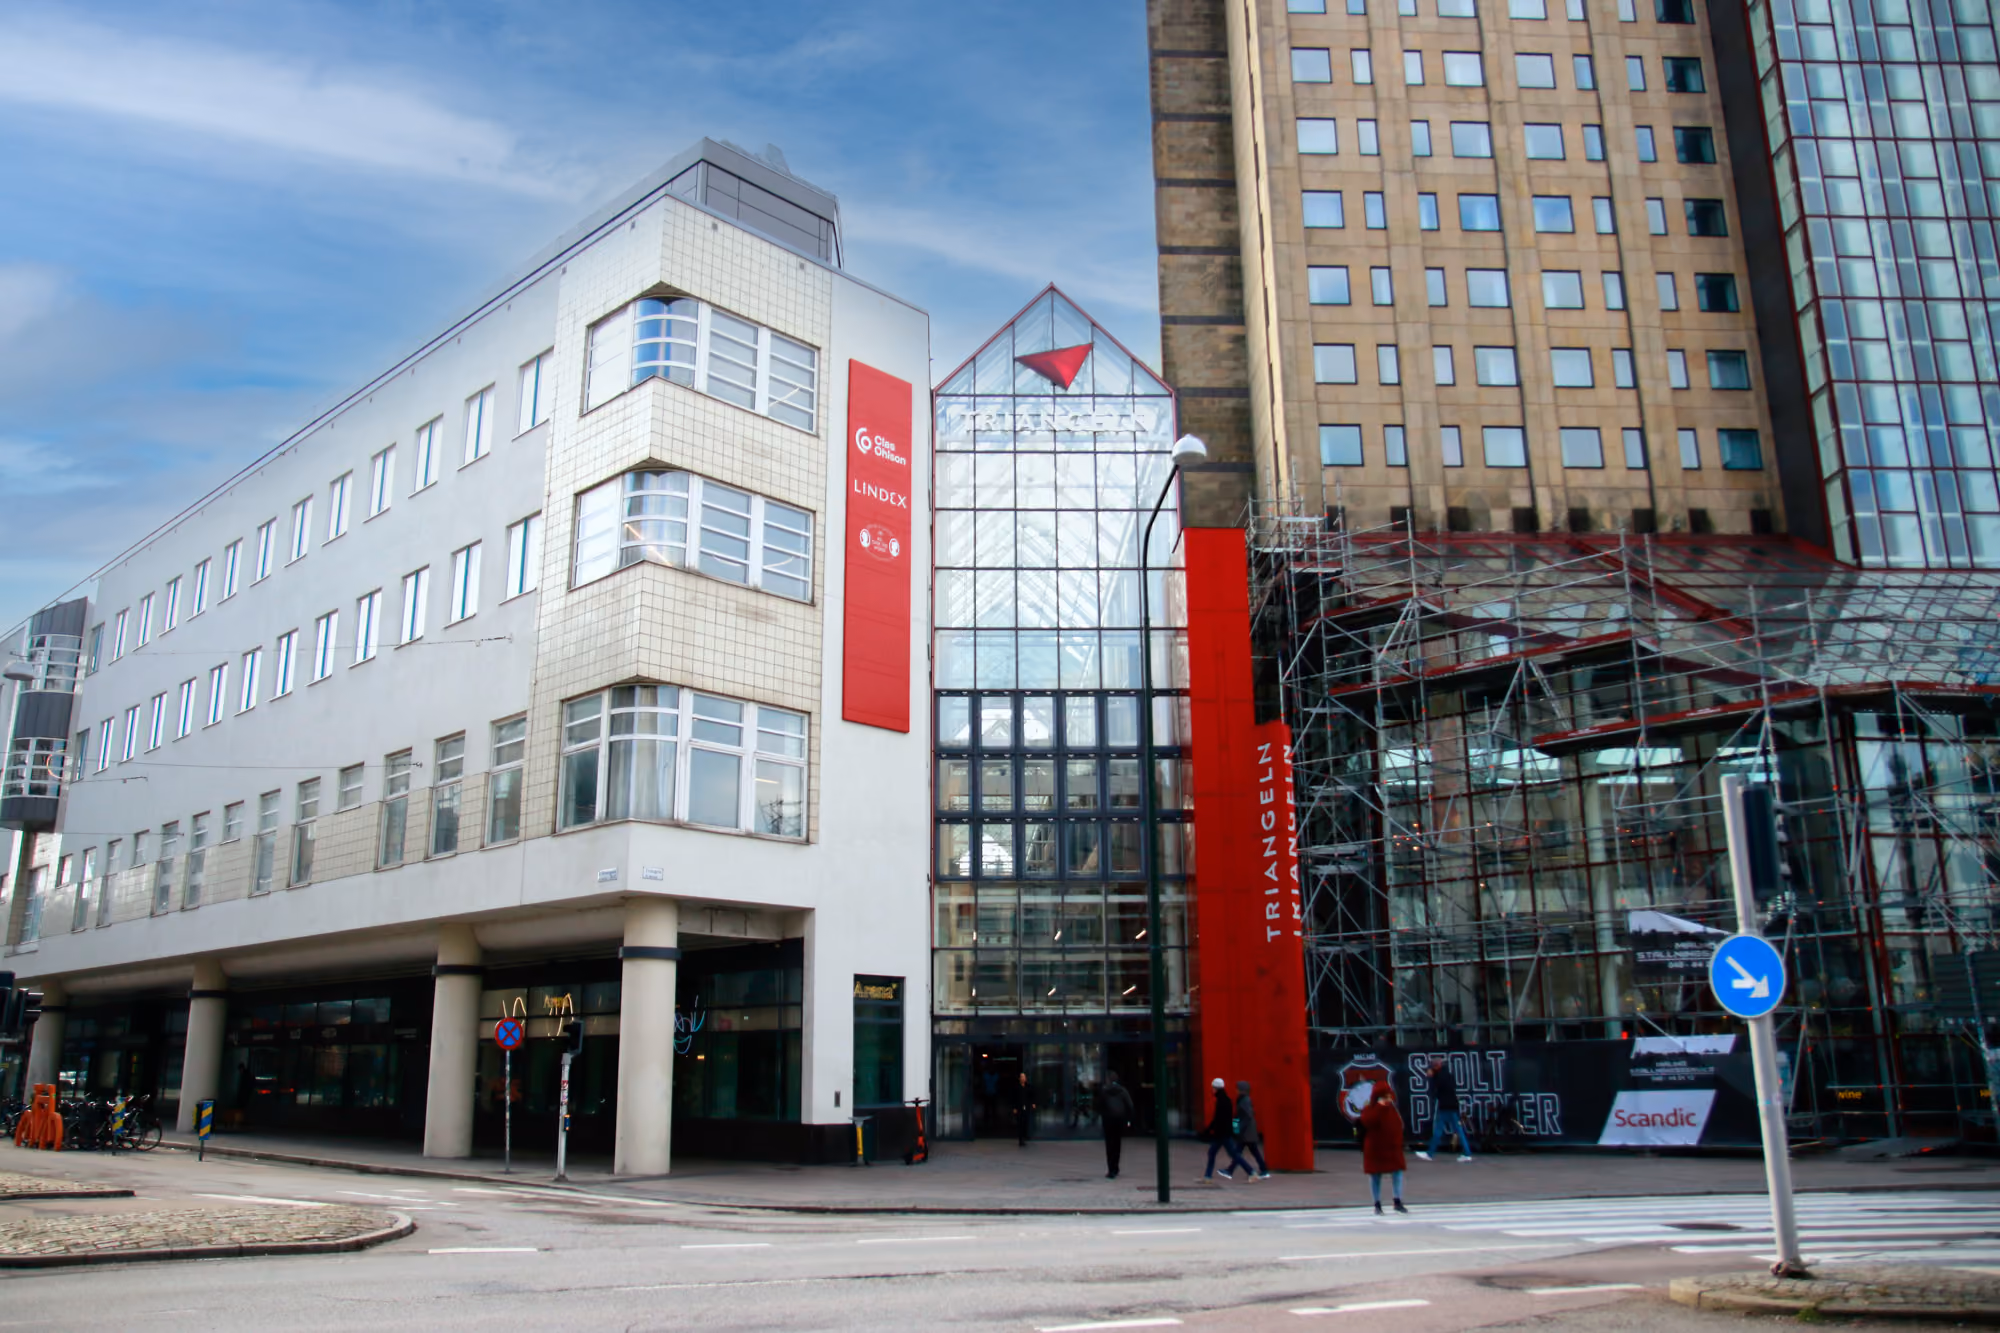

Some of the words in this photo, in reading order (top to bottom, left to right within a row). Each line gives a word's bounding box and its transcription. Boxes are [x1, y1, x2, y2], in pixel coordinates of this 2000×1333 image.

[874, 435, 896, 451] Clas
[874, 446, 907, 465] Ohlson
[854, 479, 907, 509] LINDEX
[1257, 742, 1281, 943] TRIANGELN
[1410, 1093, 1562, 1135] PRTNER
[1615, 1108, 1697, 1128] Scandic
